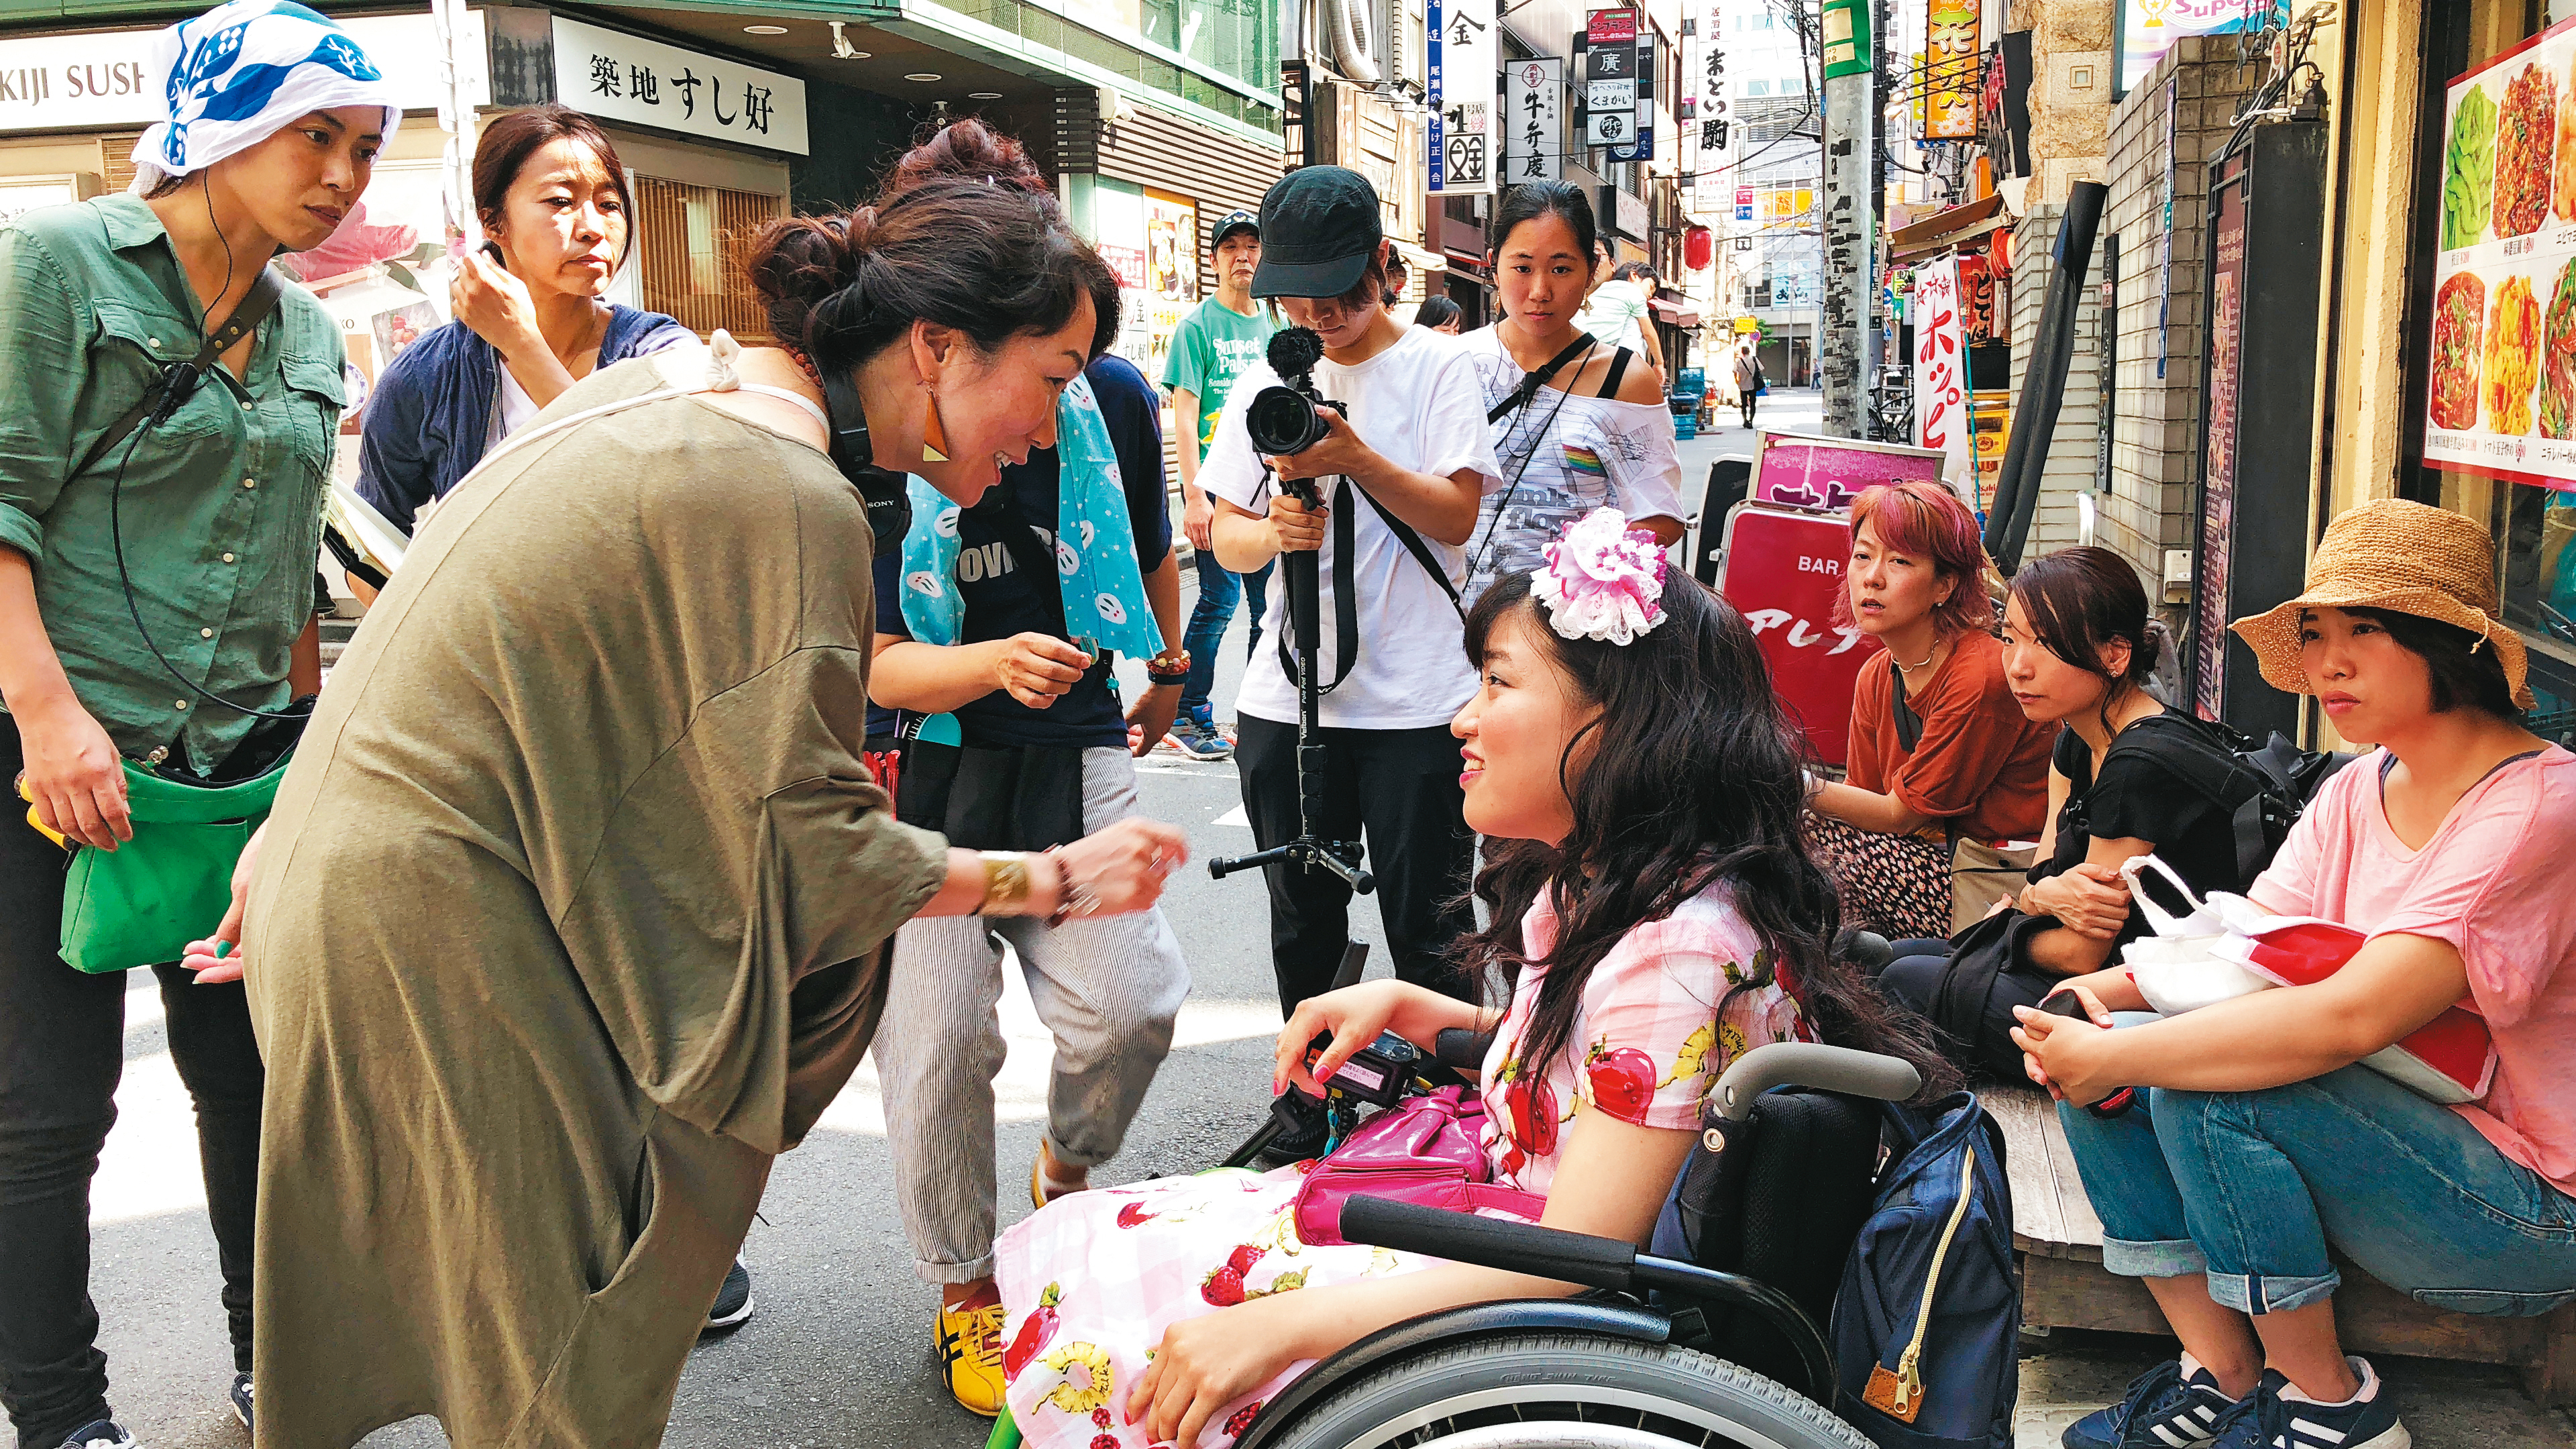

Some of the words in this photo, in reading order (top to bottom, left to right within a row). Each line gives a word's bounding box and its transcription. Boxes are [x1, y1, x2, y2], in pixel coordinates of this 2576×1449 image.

[1443, 9, 1486, 46] 金
[590, 53, 774, 135] 築地すし好
[1591, 94, 1631, 106] くまがい
[1522, 89, 1548, 178] 牛弁慶
[1212, 336, 1261, 357] Sunset
[867, 500, 894, 508] SONY
[1798, 555, 1839, 576] BAR
